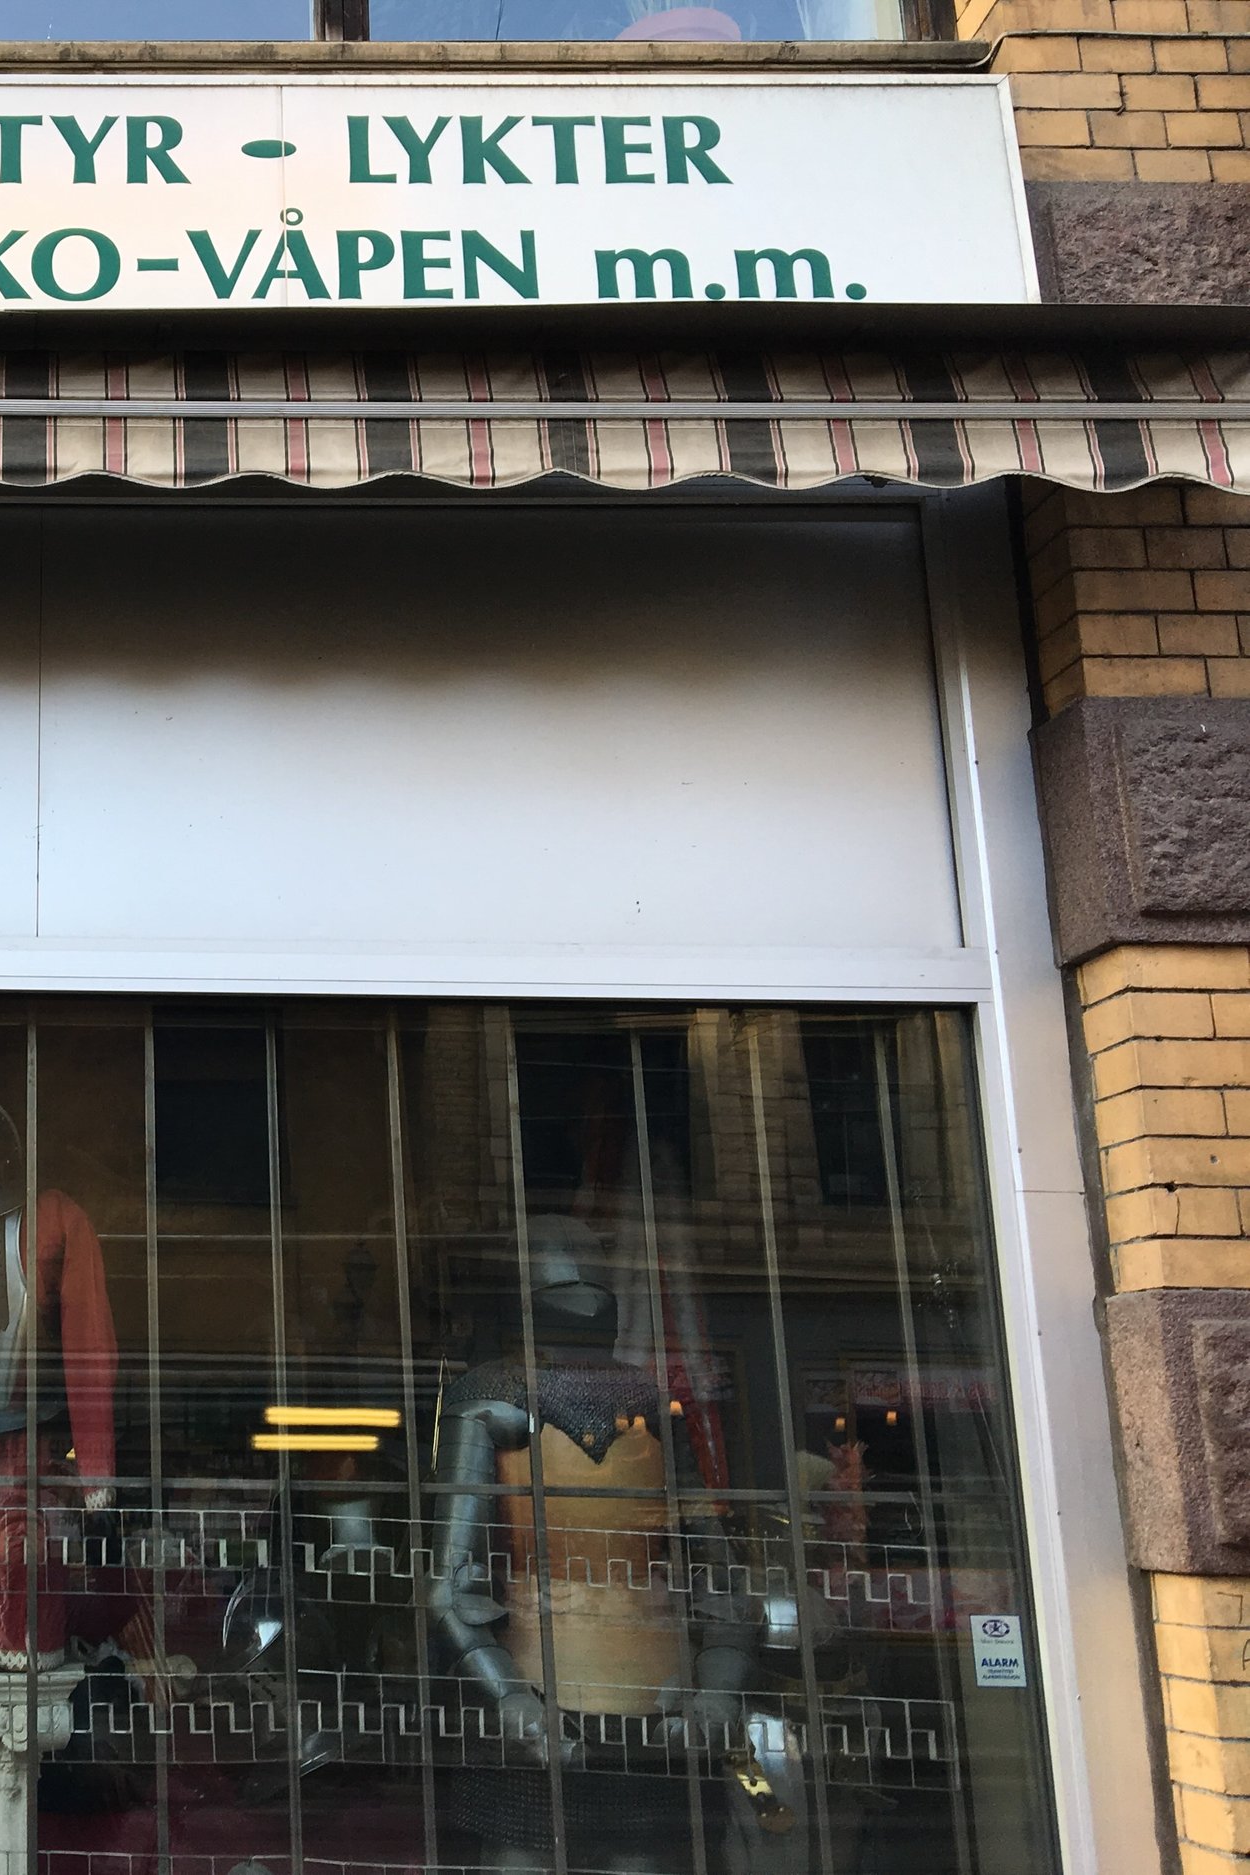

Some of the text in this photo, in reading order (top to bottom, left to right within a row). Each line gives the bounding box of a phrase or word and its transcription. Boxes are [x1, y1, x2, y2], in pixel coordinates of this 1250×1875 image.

[348, 115, 732, 186] LYKTER
[595, 248, 868, 301] m.m.
[981, 1657, 1020, 1668] ALARM
